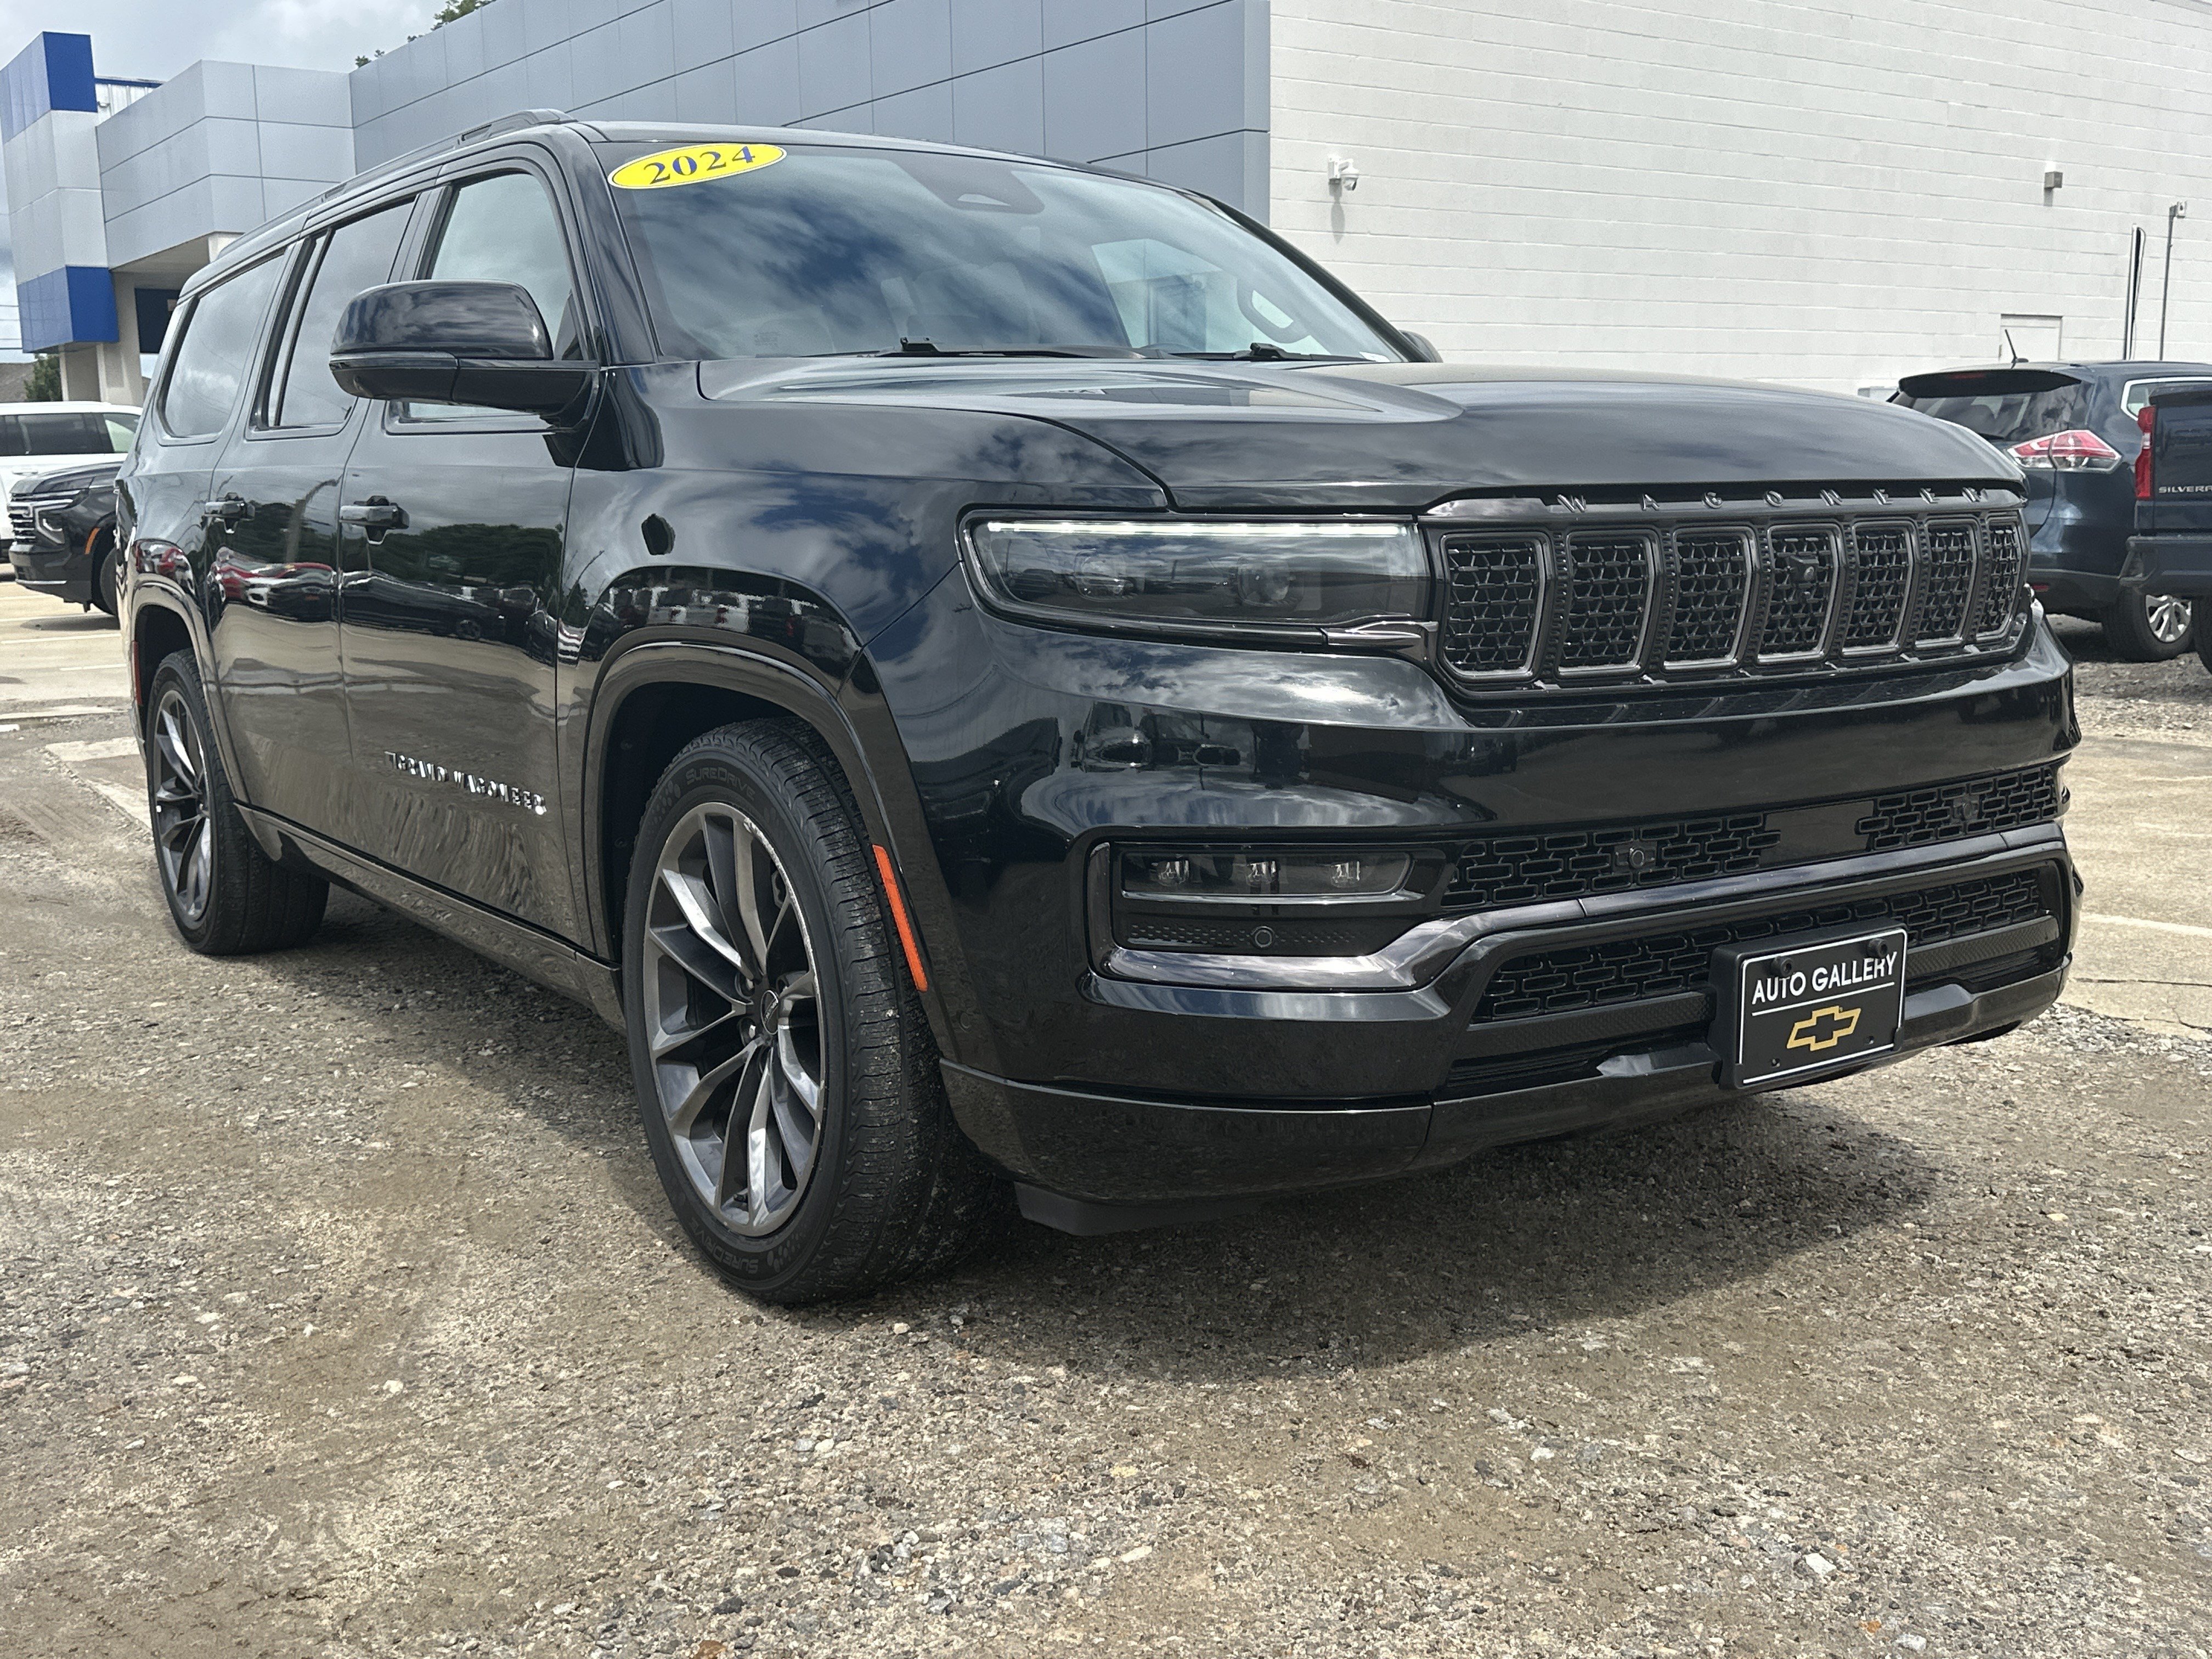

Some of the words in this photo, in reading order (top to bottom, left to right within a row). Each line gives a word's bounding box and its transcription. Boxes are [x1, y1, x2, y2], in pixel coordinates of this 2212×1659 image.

[644, 146, 755, 184] 2024
[1557, 487, 1982, 512] WAGONEER
[397, 754, 449, 782] GRAND
[454, 770, 547, 815] WAGONEER
[1752, 971, 1806, 1005] AUTO
[1812, 951, 1897, 991] GALLERY
